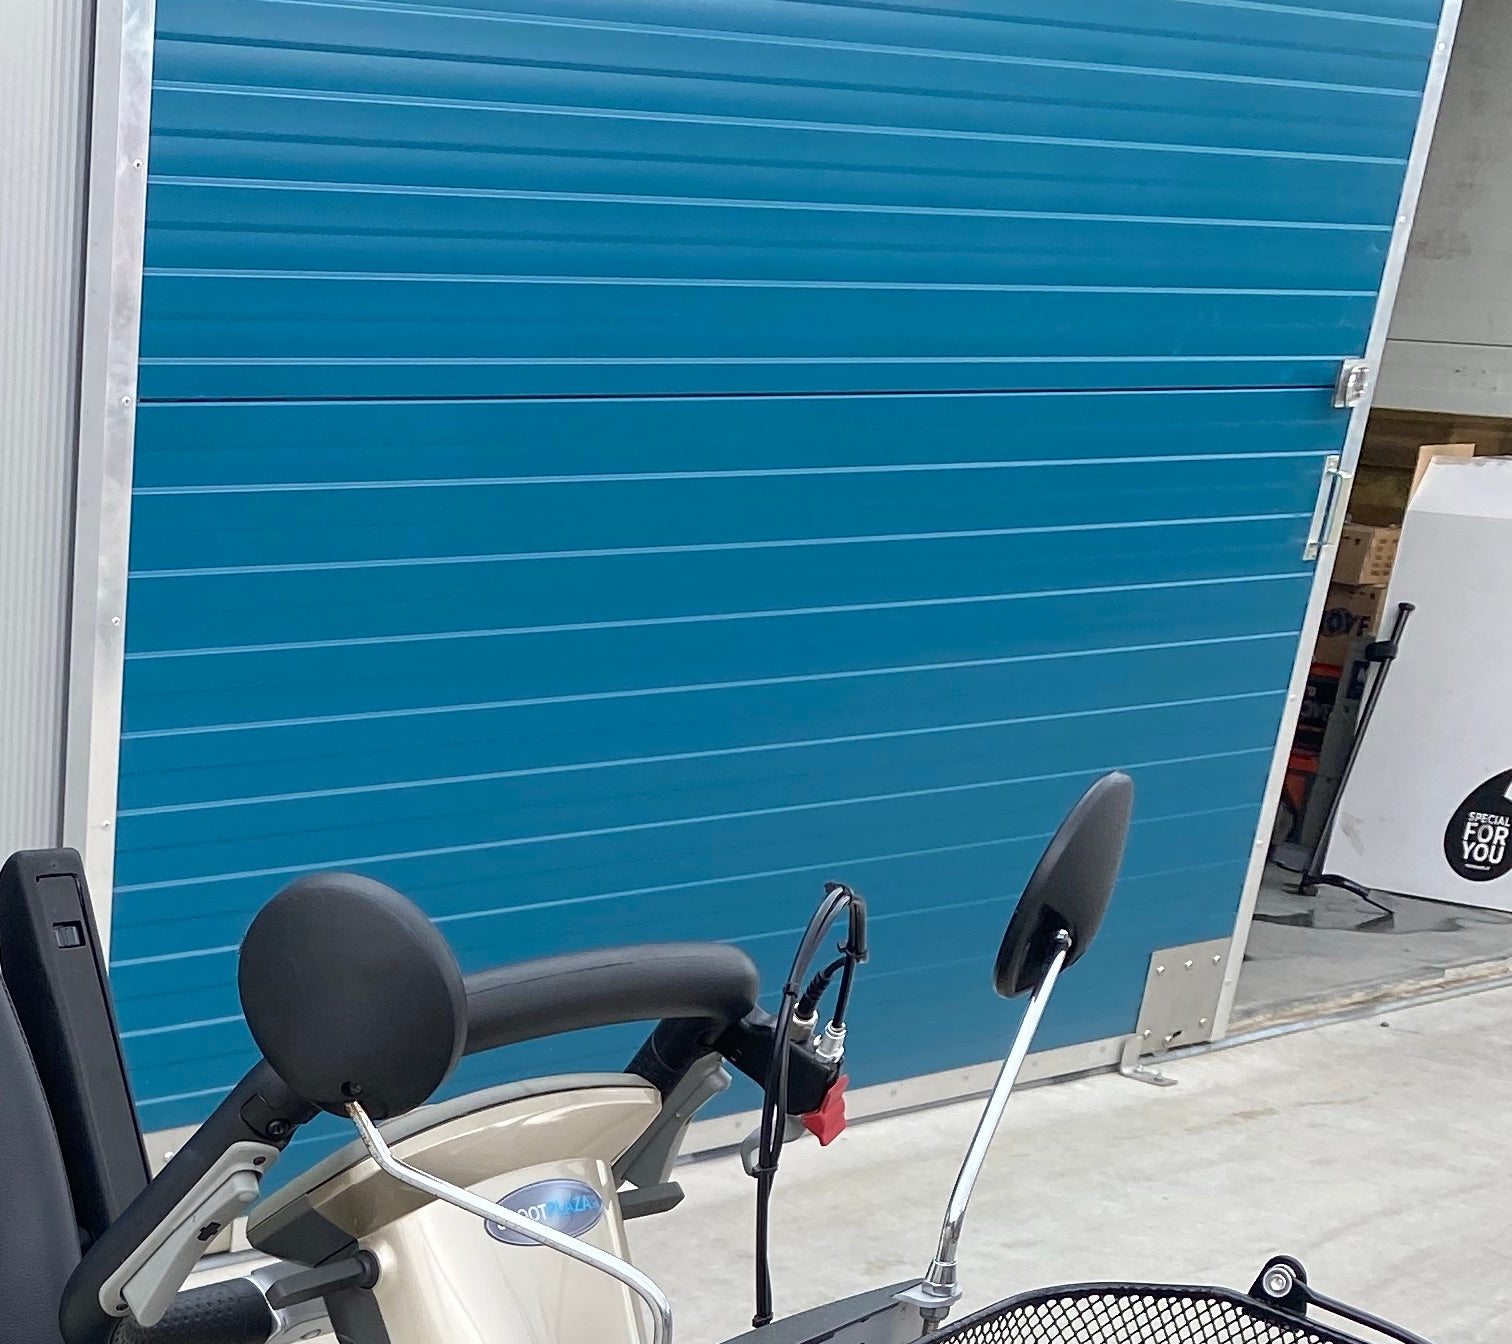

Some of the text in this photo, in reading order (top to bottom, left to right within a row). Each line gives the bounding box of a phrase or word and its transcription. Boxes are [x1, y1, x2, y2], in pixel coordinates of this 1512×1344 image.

[1468, 811, 1511, 827] SPECIAL
[1463, 822, 1509, 846] FOR
[1462, 841, 1505, 865] YOU
